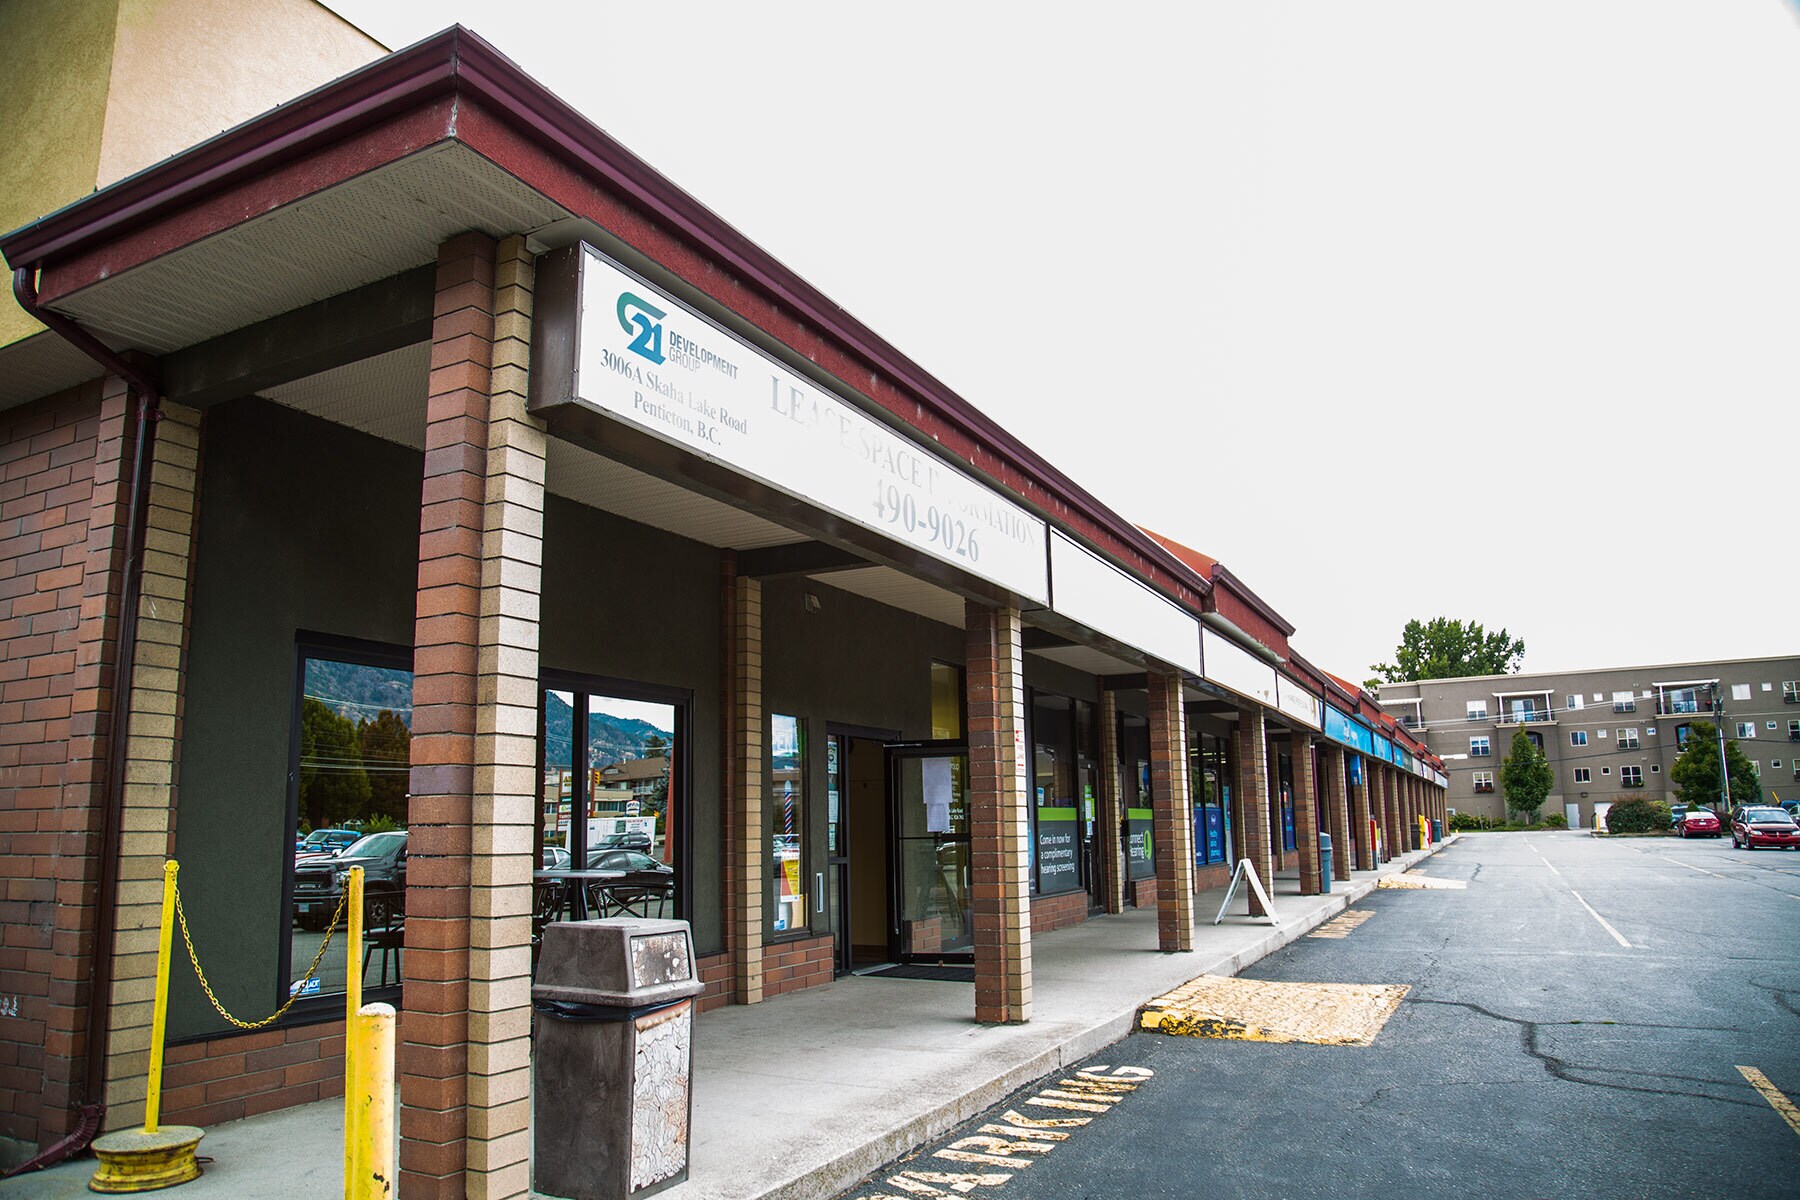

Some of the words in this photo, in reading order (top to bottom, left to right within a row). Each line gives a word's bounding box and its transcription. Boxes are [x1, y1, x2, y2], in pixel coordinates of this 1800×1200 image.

[668, 347, 701, 373] GROUP
[669, 331, 739, 379] DEVELOPMENT
[600, 348, 643, 385] 3006A
[646, 370, 684, 404] Skaha
[688, 391, 717, 420] Lake
[720, 407, 747, 434] Road
[697, 421, 722, 446] B.C.
[857, 427, 923, 489] SPACE
[871, 479, 980, 562] 490-9026
[1039, 834, 1052, 845] Come
[1056, 836, 1064, 844] now
[1044, 848, 1073, 861] complimentary
[1040, 863, 1057, 876] hearing
[1056, 861, 1075, 873] screening
